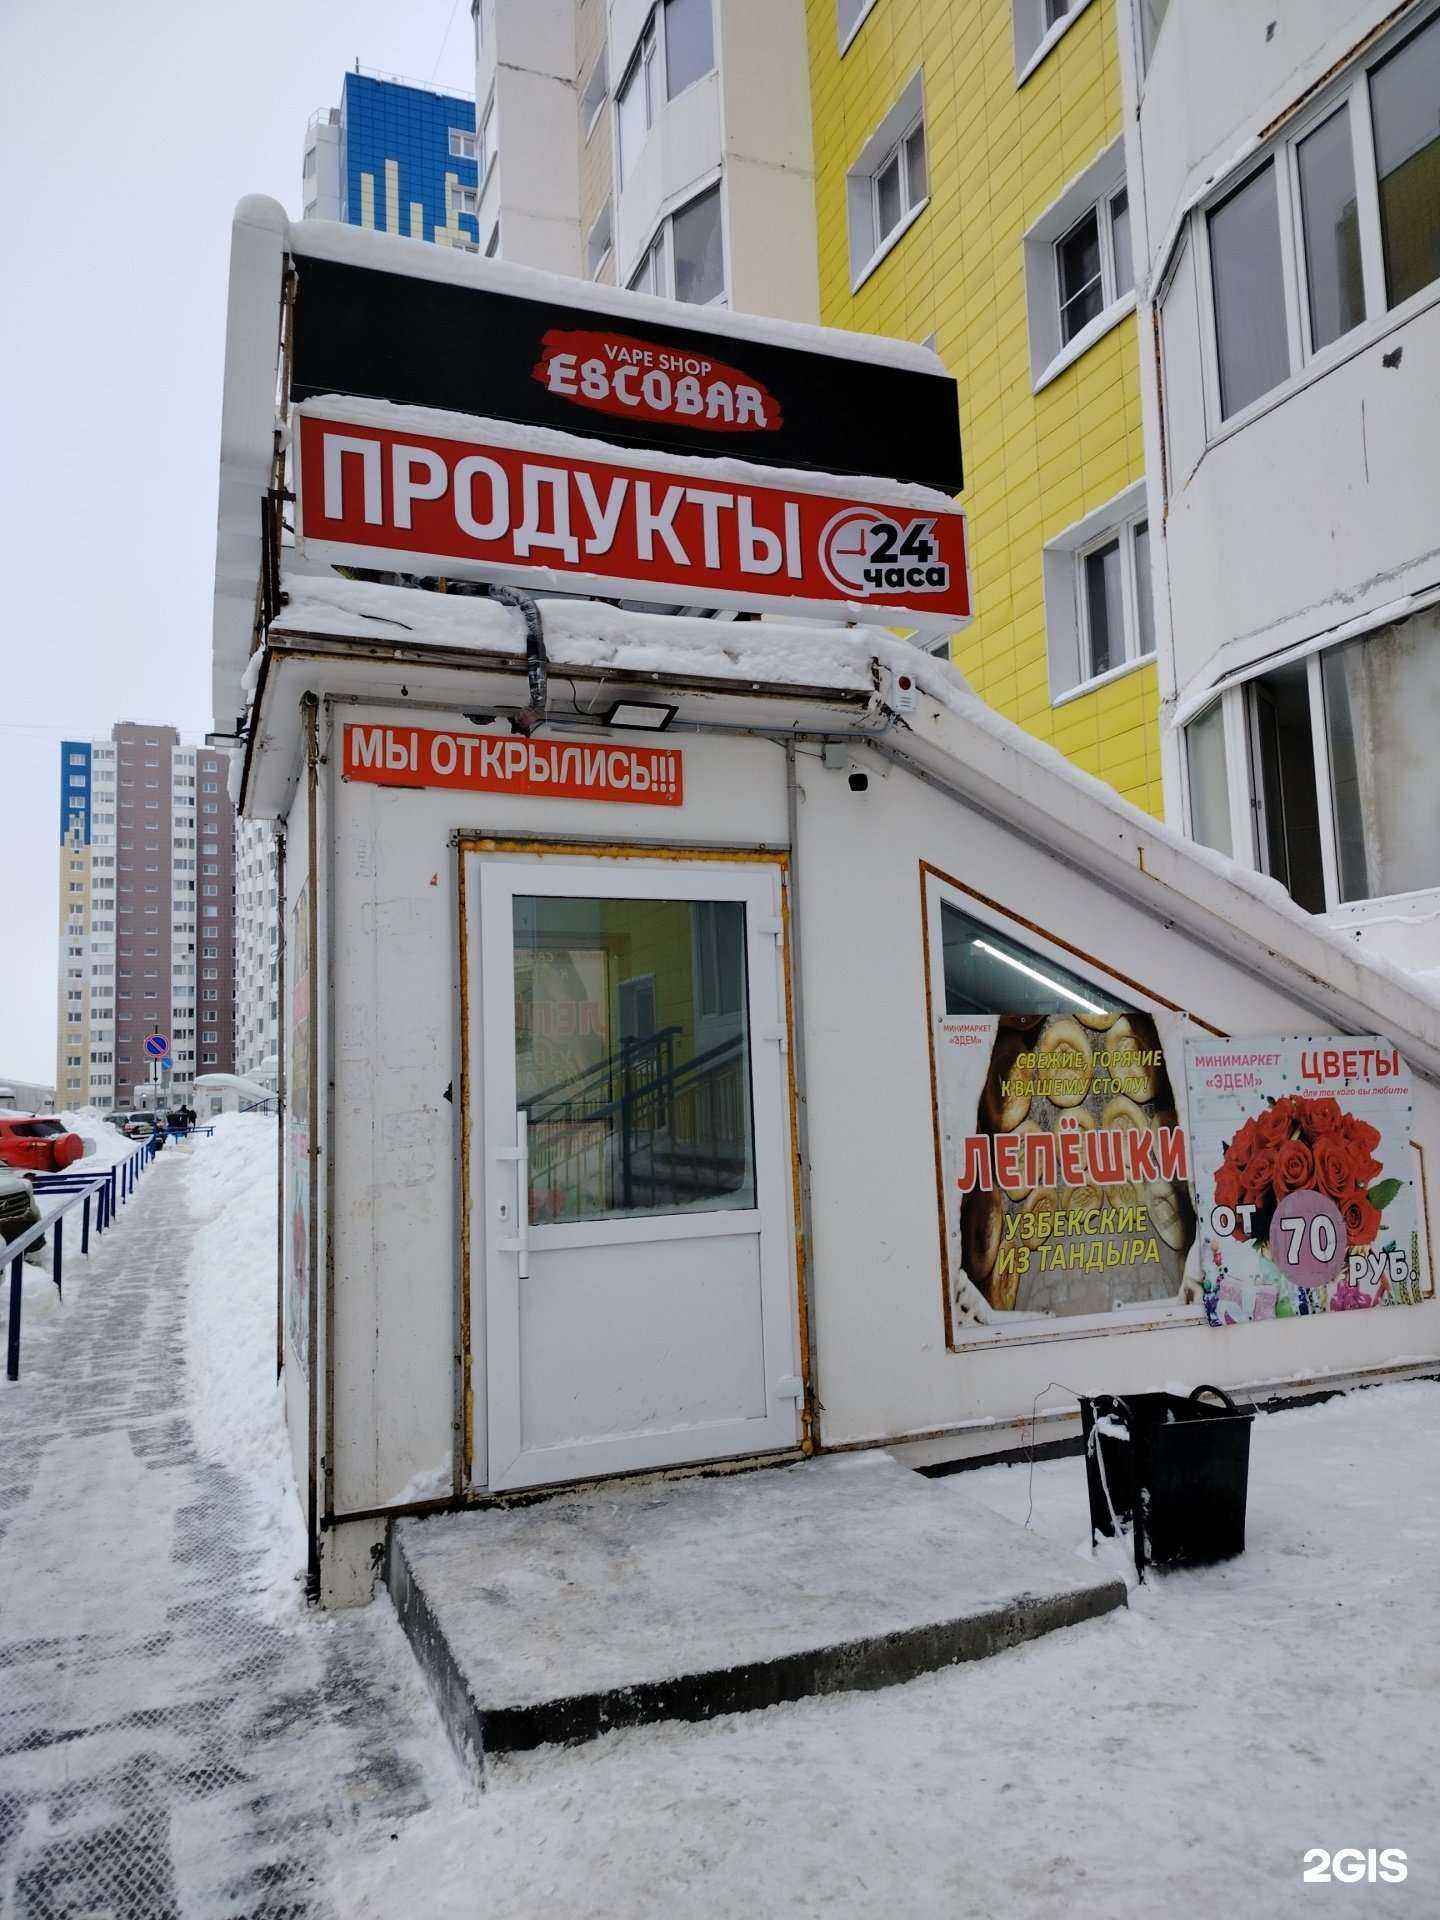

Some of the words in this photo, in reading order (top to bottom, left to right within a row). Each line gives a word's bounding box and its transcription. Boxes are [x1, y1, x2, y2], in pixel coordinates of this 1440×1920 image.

[604, 343, 654, 368] VAPE
[659, 354, 712, 377] SHOP
[547, 353, 768, 428] ESCOBAR
[323, 432, 802, 578] ПРОДУКТЫ
[870, 523, 933, 564] 24
[863, 567, 945, 588] часа
[351, 727, 418, 771] МЫ
[430, 734, 677, 793] ОТКРЫЛИСЬ!!!
[943, 1024, 992, 1033] МИНИМАРКЕТ
[1016, 1052, 1089, 1072] СВЕЖИЕ,
[1092, 1050, 1163, 1068] ГОРЯЧИЕ
[1195, 1054, 1282, 1068] МИНИМАРКЕТ
[1301, 1049, 1400, 1085] ЦВЕТЫ
[1001, 1080, 1012, 1097] К
[1014, 1078, 1090, 1097] ВАШЕМУ
[1092, 1076, 1150, 1096] СТОЛУ!
[1206, 1072, 1264, 1092] «ЭДЕМ»
[957, 1117, 1189, 1193] ЛЕПЁШКИ
[1005, 1206, 1149, 1241] УЗБЕКСКИЕ
[1210, 1203, 1257, 1237] ОТ
[998, 1246, 1031, 1275] ИЗ
[1037, 1238, 1162, 1274] ТАНДЫРА
[1279, 1214, 1338, 1266] 70
[1348, 1249, 1420, 1287] РУБ.
